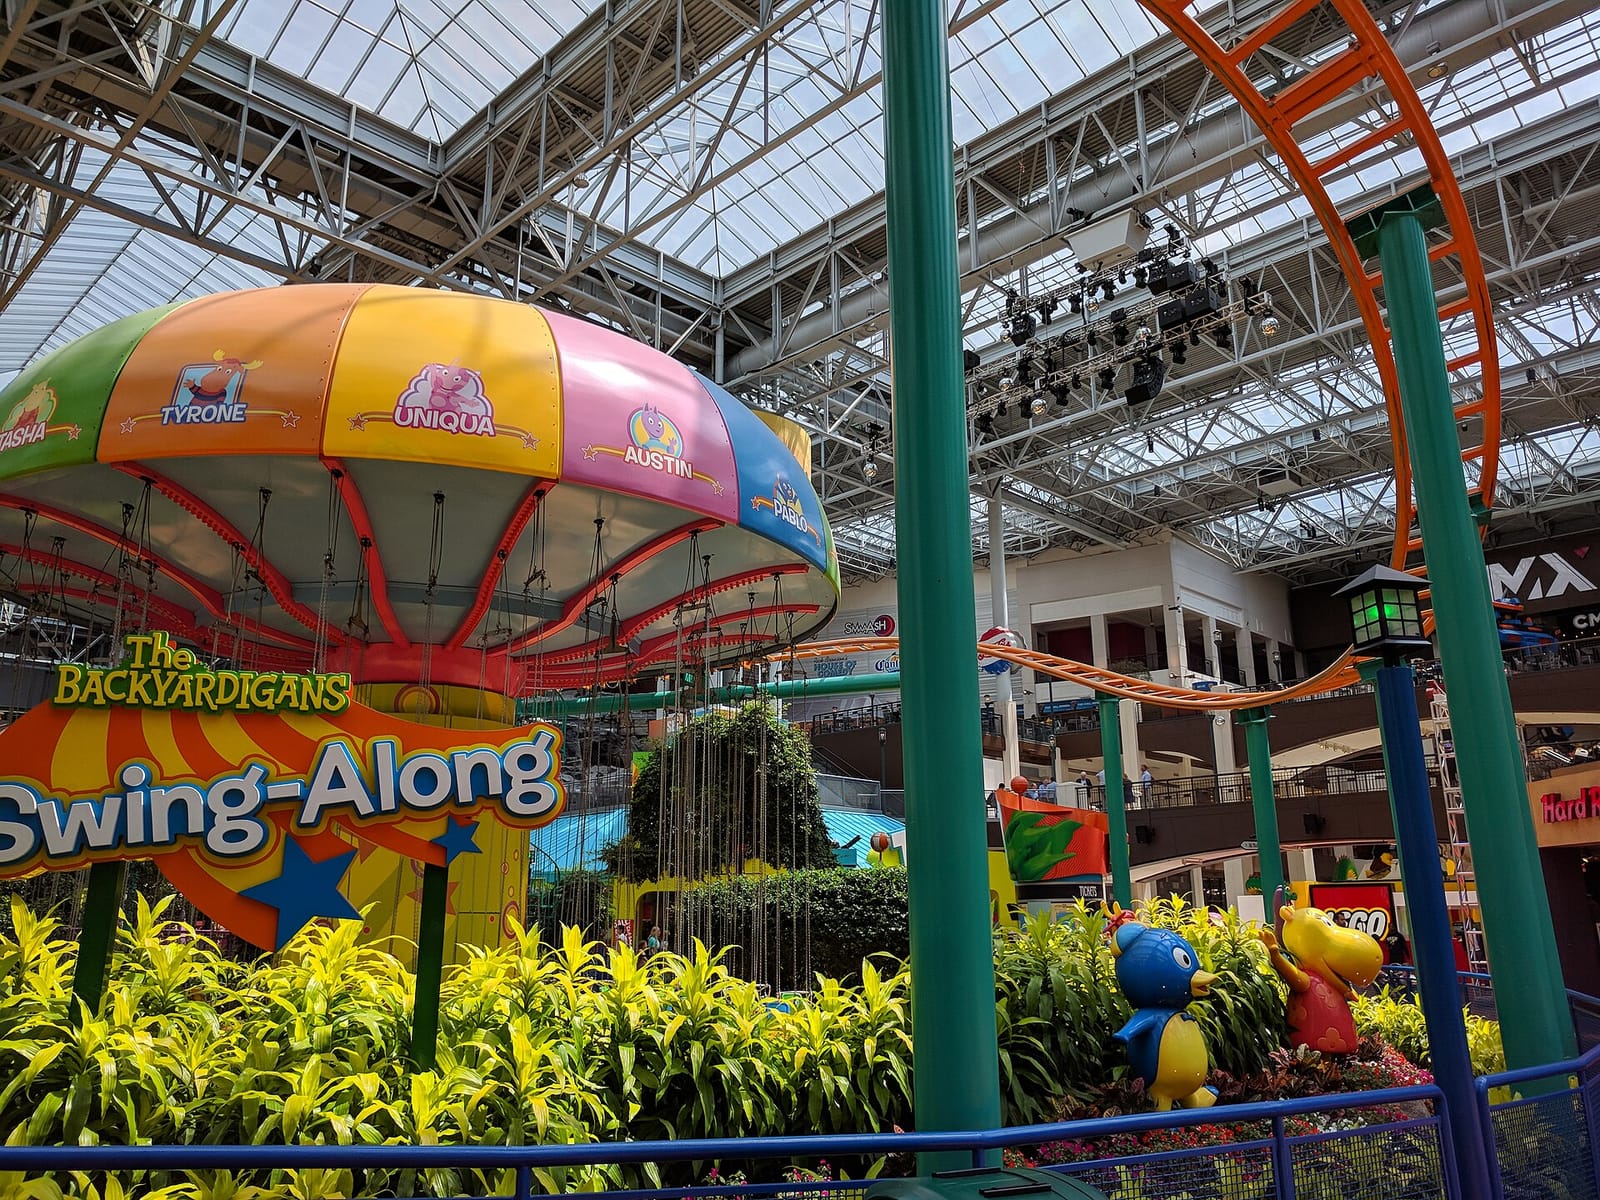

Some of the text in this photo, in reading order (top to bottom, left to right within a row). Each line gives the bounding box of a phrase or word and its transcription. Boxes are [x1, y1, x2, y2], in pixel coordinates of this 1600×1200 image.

[162, 403, 247, 424] TYRONE
[394, 405, 496, 436] UNIQUA
[625, 445, 693, 479] AUSTIN
[773, 499, 808, 534] PABLO
[126, 631, 193, 671] The
[53, 664, 349, 713] BACKYARDIGANS
[0, 731, 555, 864] Swing-Along
[1541, 787, 1587, 824] Hard
[1078, 885, 1098, 897] TICKETS
